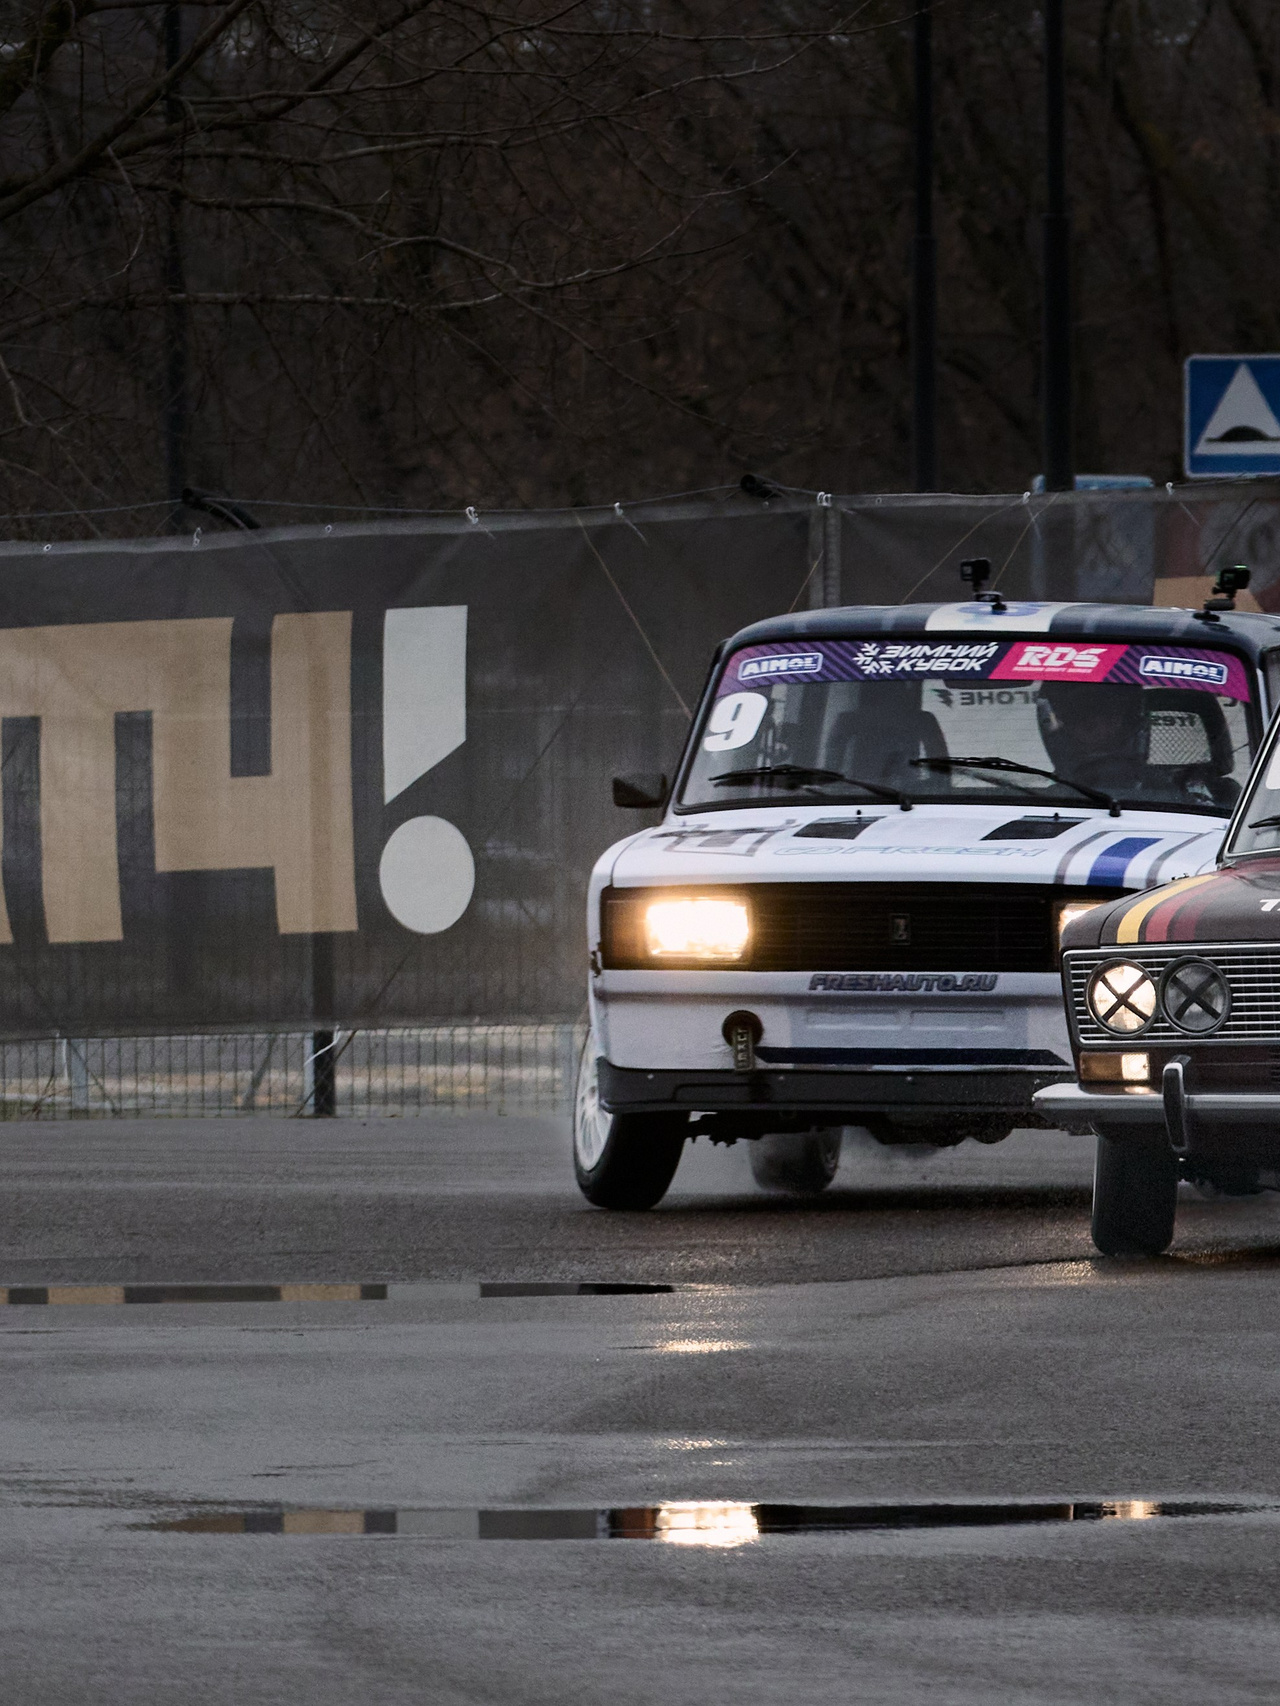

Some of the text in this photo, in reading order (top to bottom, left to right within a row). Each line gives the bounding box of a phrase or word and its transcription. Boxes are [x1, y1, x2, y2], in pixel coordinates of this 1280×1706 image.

[879, 641, 999, 658] ЗИМНИЙ
[1016, 645, 1108, 668] RDS
[742, 657, 818, 676] AIMOL
[895, 658, 989, 671] КУБОК
[1143, 660, 1223, 680] AIMOL
[703, 691, 769, 752] 9
[0, 604, 477, 944] ТЧ!
[841, 845, 1048, 858] FRESH
[808, 974, 999, 991] FRESHAUTO.RU
